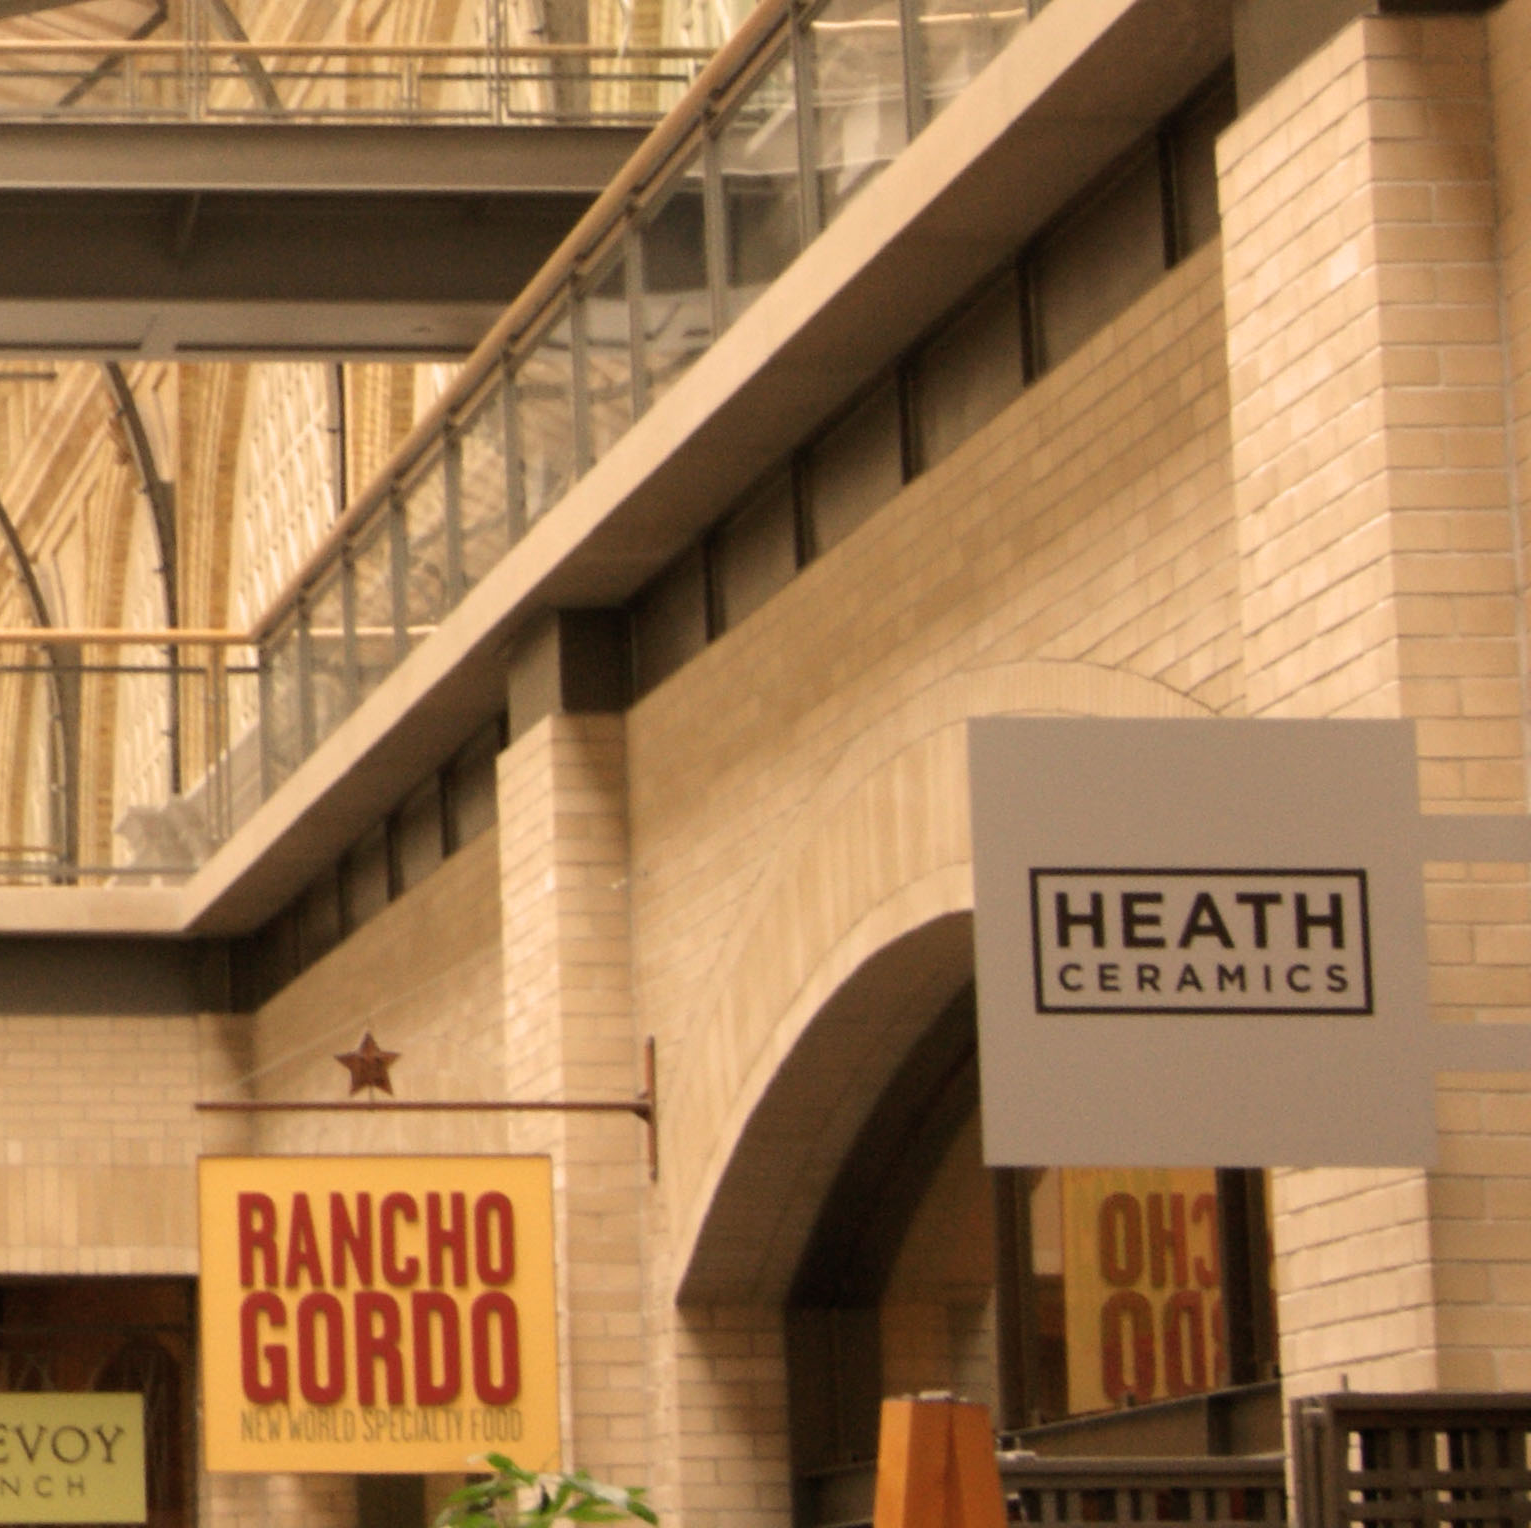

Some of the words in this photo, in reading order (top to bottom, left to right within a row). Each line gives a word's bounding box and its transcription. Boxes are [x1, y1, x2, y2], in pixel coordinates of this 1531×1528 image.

[1055, 891, 1345, 949] HEATH
[1058, 963, 1348, 993] CERAMICS
[238, 1190, 516, 1289] RANCHO
[240, 1290, 521, 1407] GORDO
[241, 1409, 283, 1443] NEW
[288, 1409, 357, 1443] WORLD
[361, 1408, 465, 1443] SPECIALTY
[469, 1408, 524, 1443] FOOD
